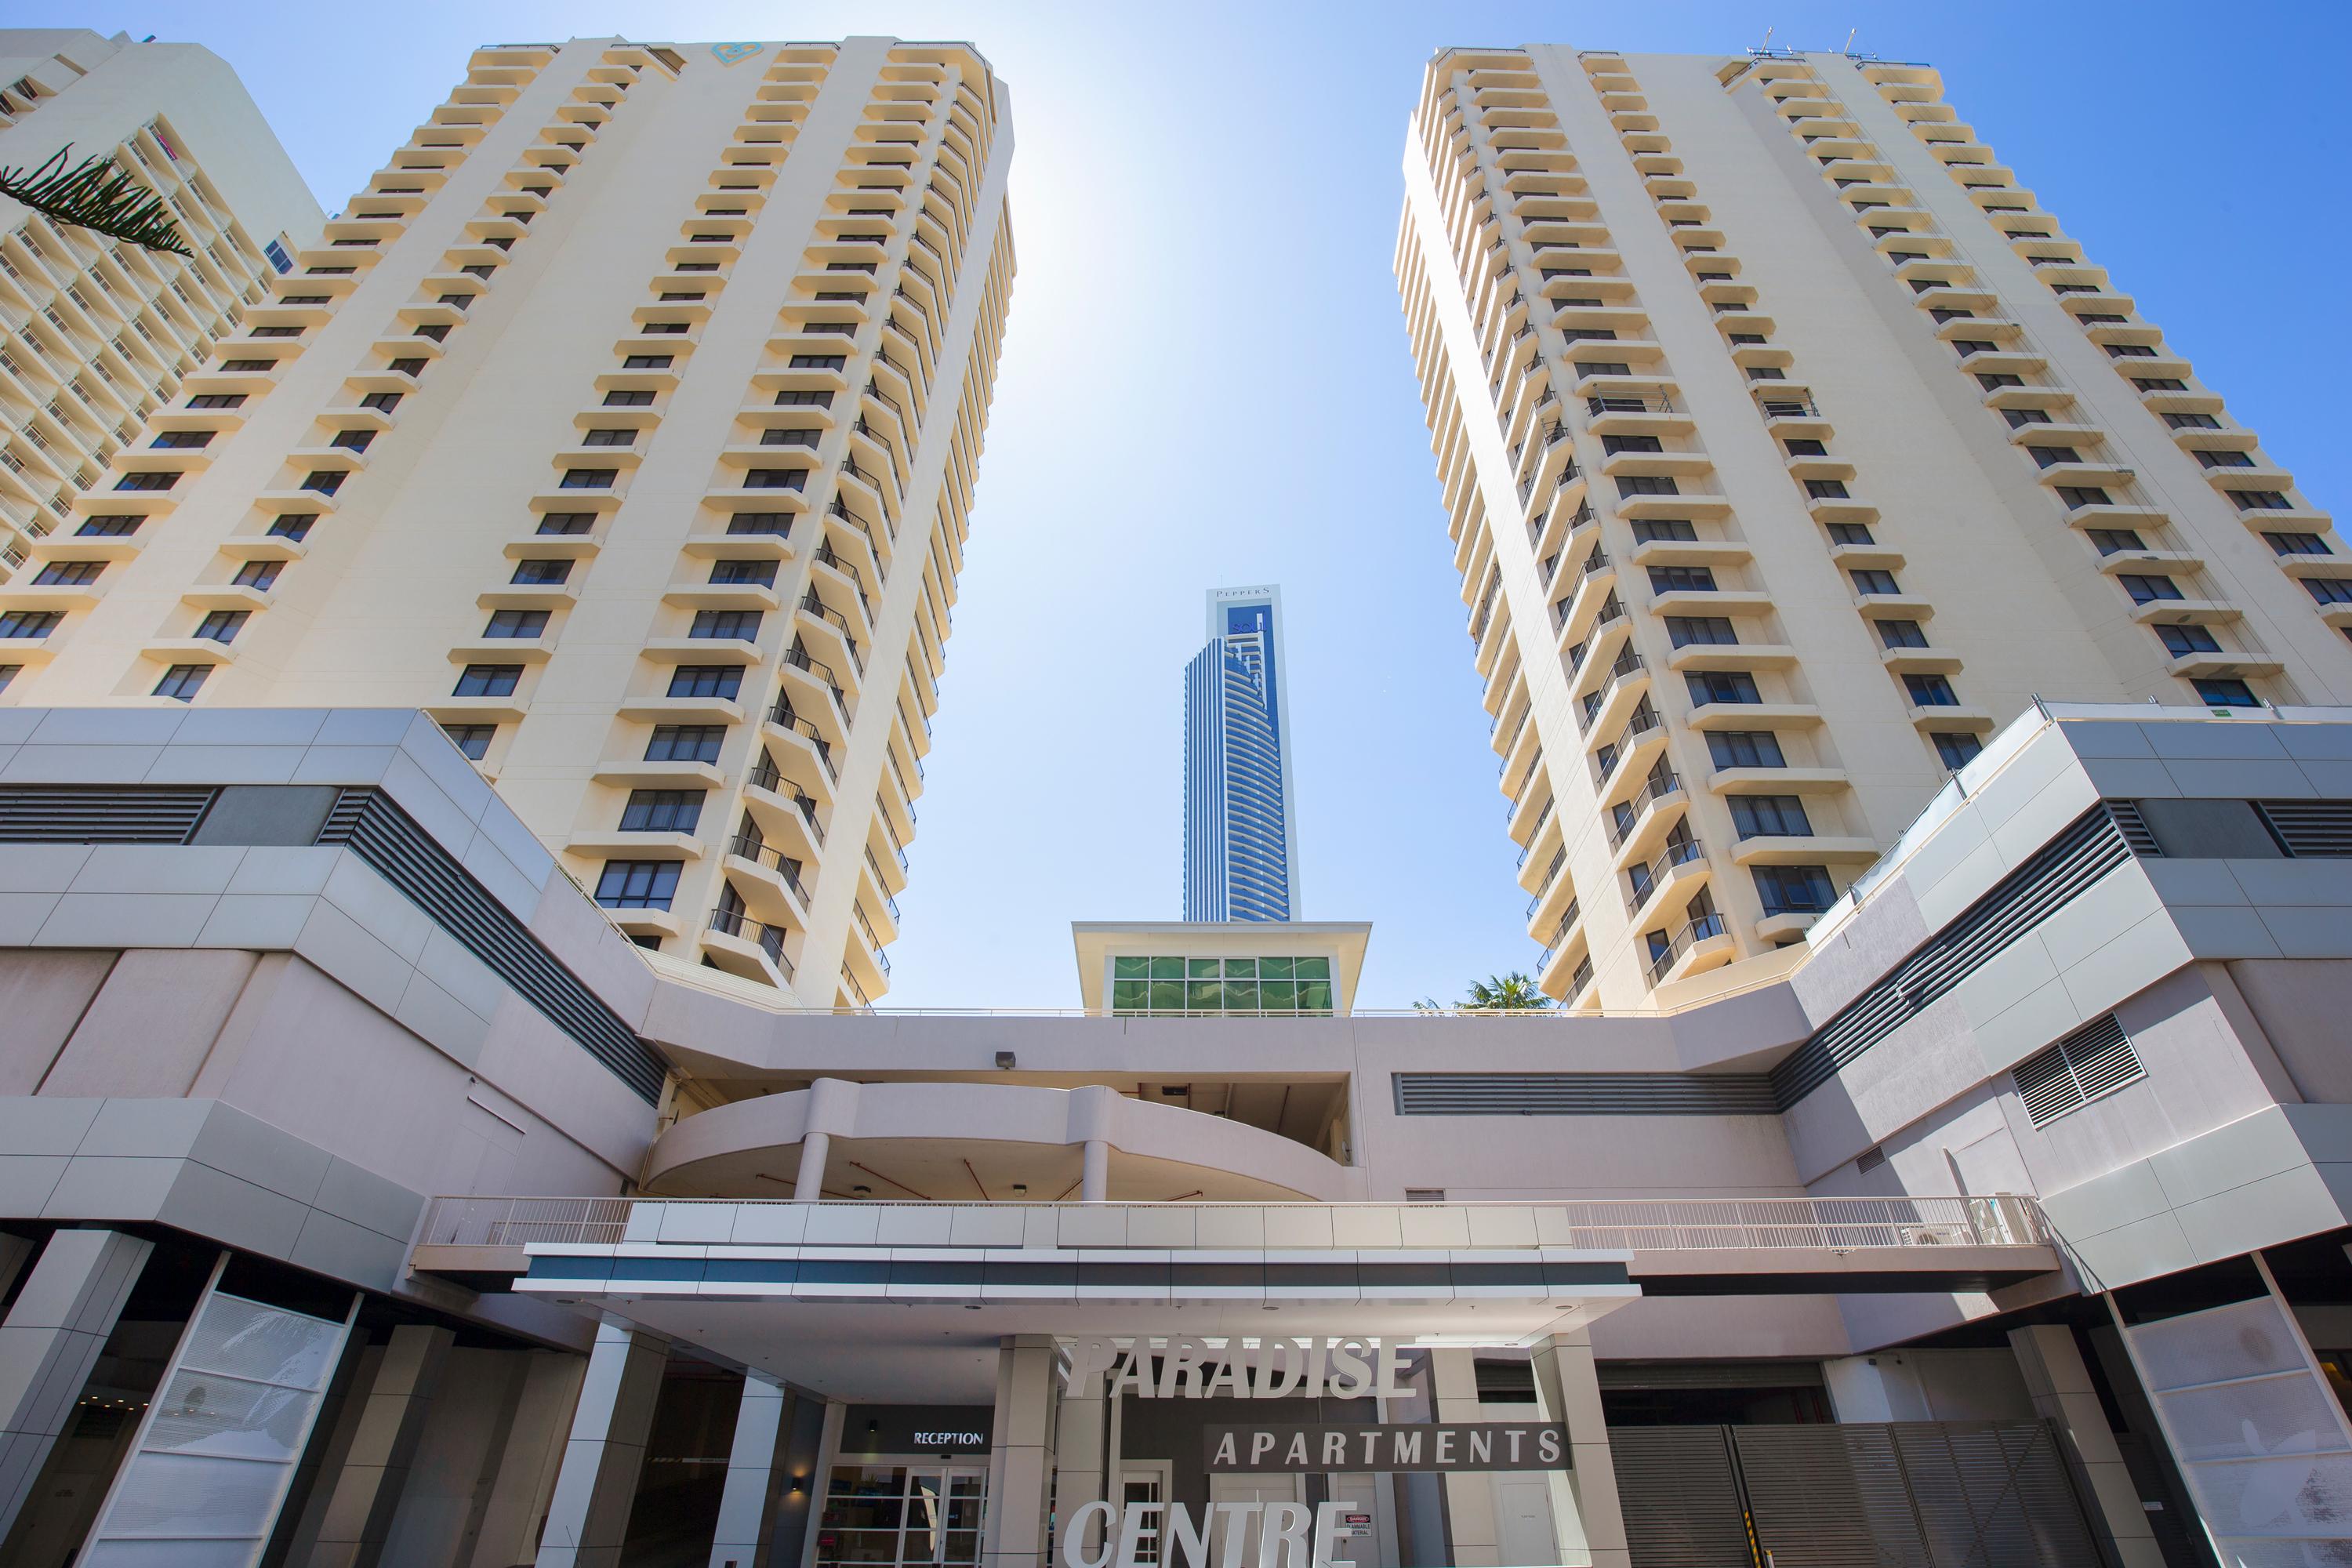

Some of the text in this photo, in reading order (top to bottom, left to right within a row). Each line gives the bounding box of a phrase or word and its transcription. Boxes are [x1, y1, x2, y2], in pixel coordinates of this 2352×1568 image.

[1065, 1336, 1417, 1399] PARADISE
[913, 1432, 984, 1445] RECEPTION
[1213, 1429, 1560, 1465] APARTMENTS
[1062, 1501, 1358, 1568] CENTRE
